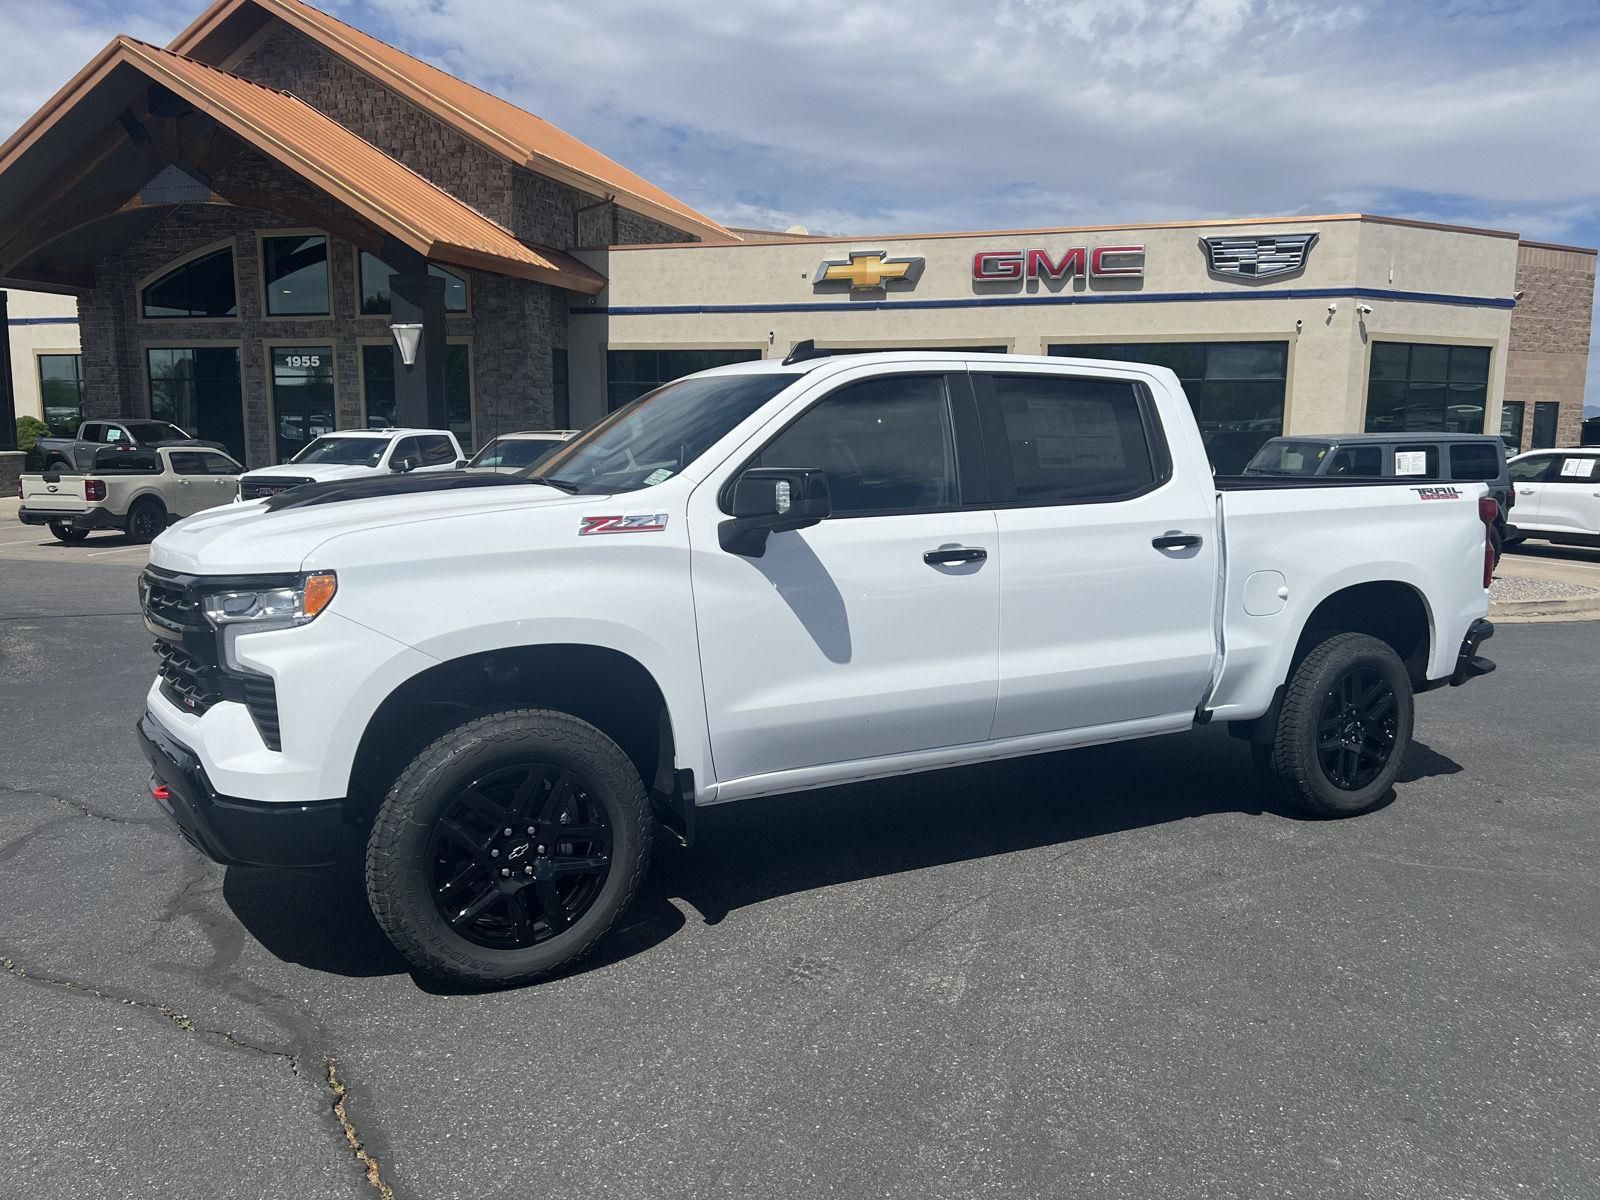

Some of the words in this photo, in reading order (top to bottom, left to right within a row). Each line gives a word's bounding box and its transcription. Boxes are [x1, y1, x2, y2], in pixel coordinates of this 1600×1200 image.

[972, 245, 1145, 282] GMC
[285, 355, 320, 367] 1955
[1410, 487, 1463, 496] TRAIL
[578, 513, 669, 536] Z71
